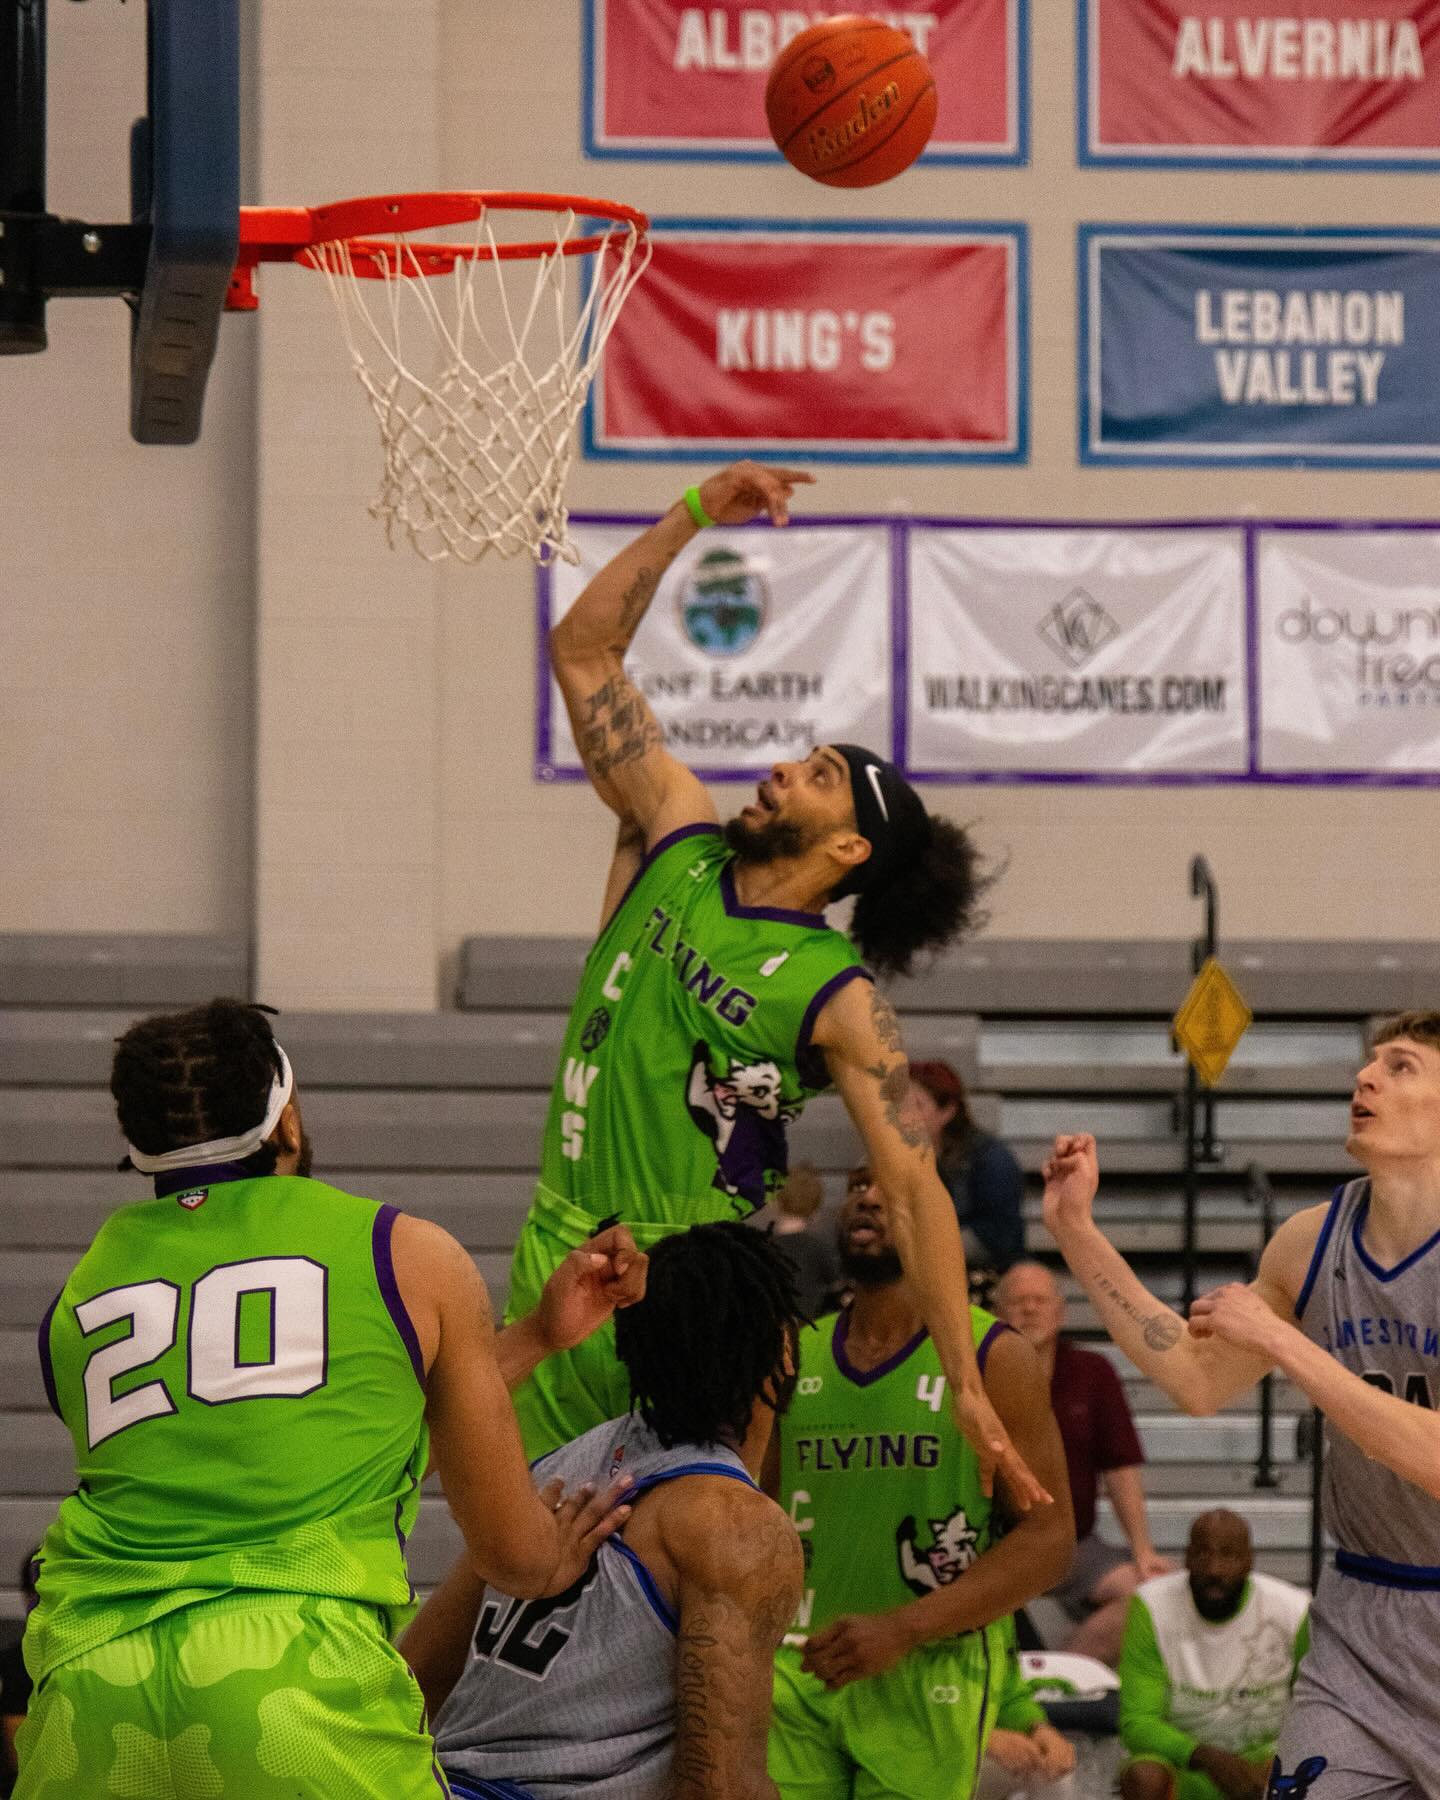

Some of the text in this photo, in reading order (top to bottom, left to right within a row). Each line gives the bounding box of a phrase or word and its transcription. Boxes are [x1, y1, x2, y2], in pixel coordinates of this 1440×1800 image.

[1172, 17, 1425, 79] ALVERNIA
[715, 308, 896, 372] KING'S
[1195, 288, 1405, 345] LEBANON
[1213, 349, 1386, 405] VALLEY
[1276, 594, 1440, 645] down
[923, 672, 1227, 714] WALKINGCANES.COM
[73, 1255, 329, 1454] 20
[915, 1374, 946, 1412] 4
[795, 1433, 941, 1471] FLYING
